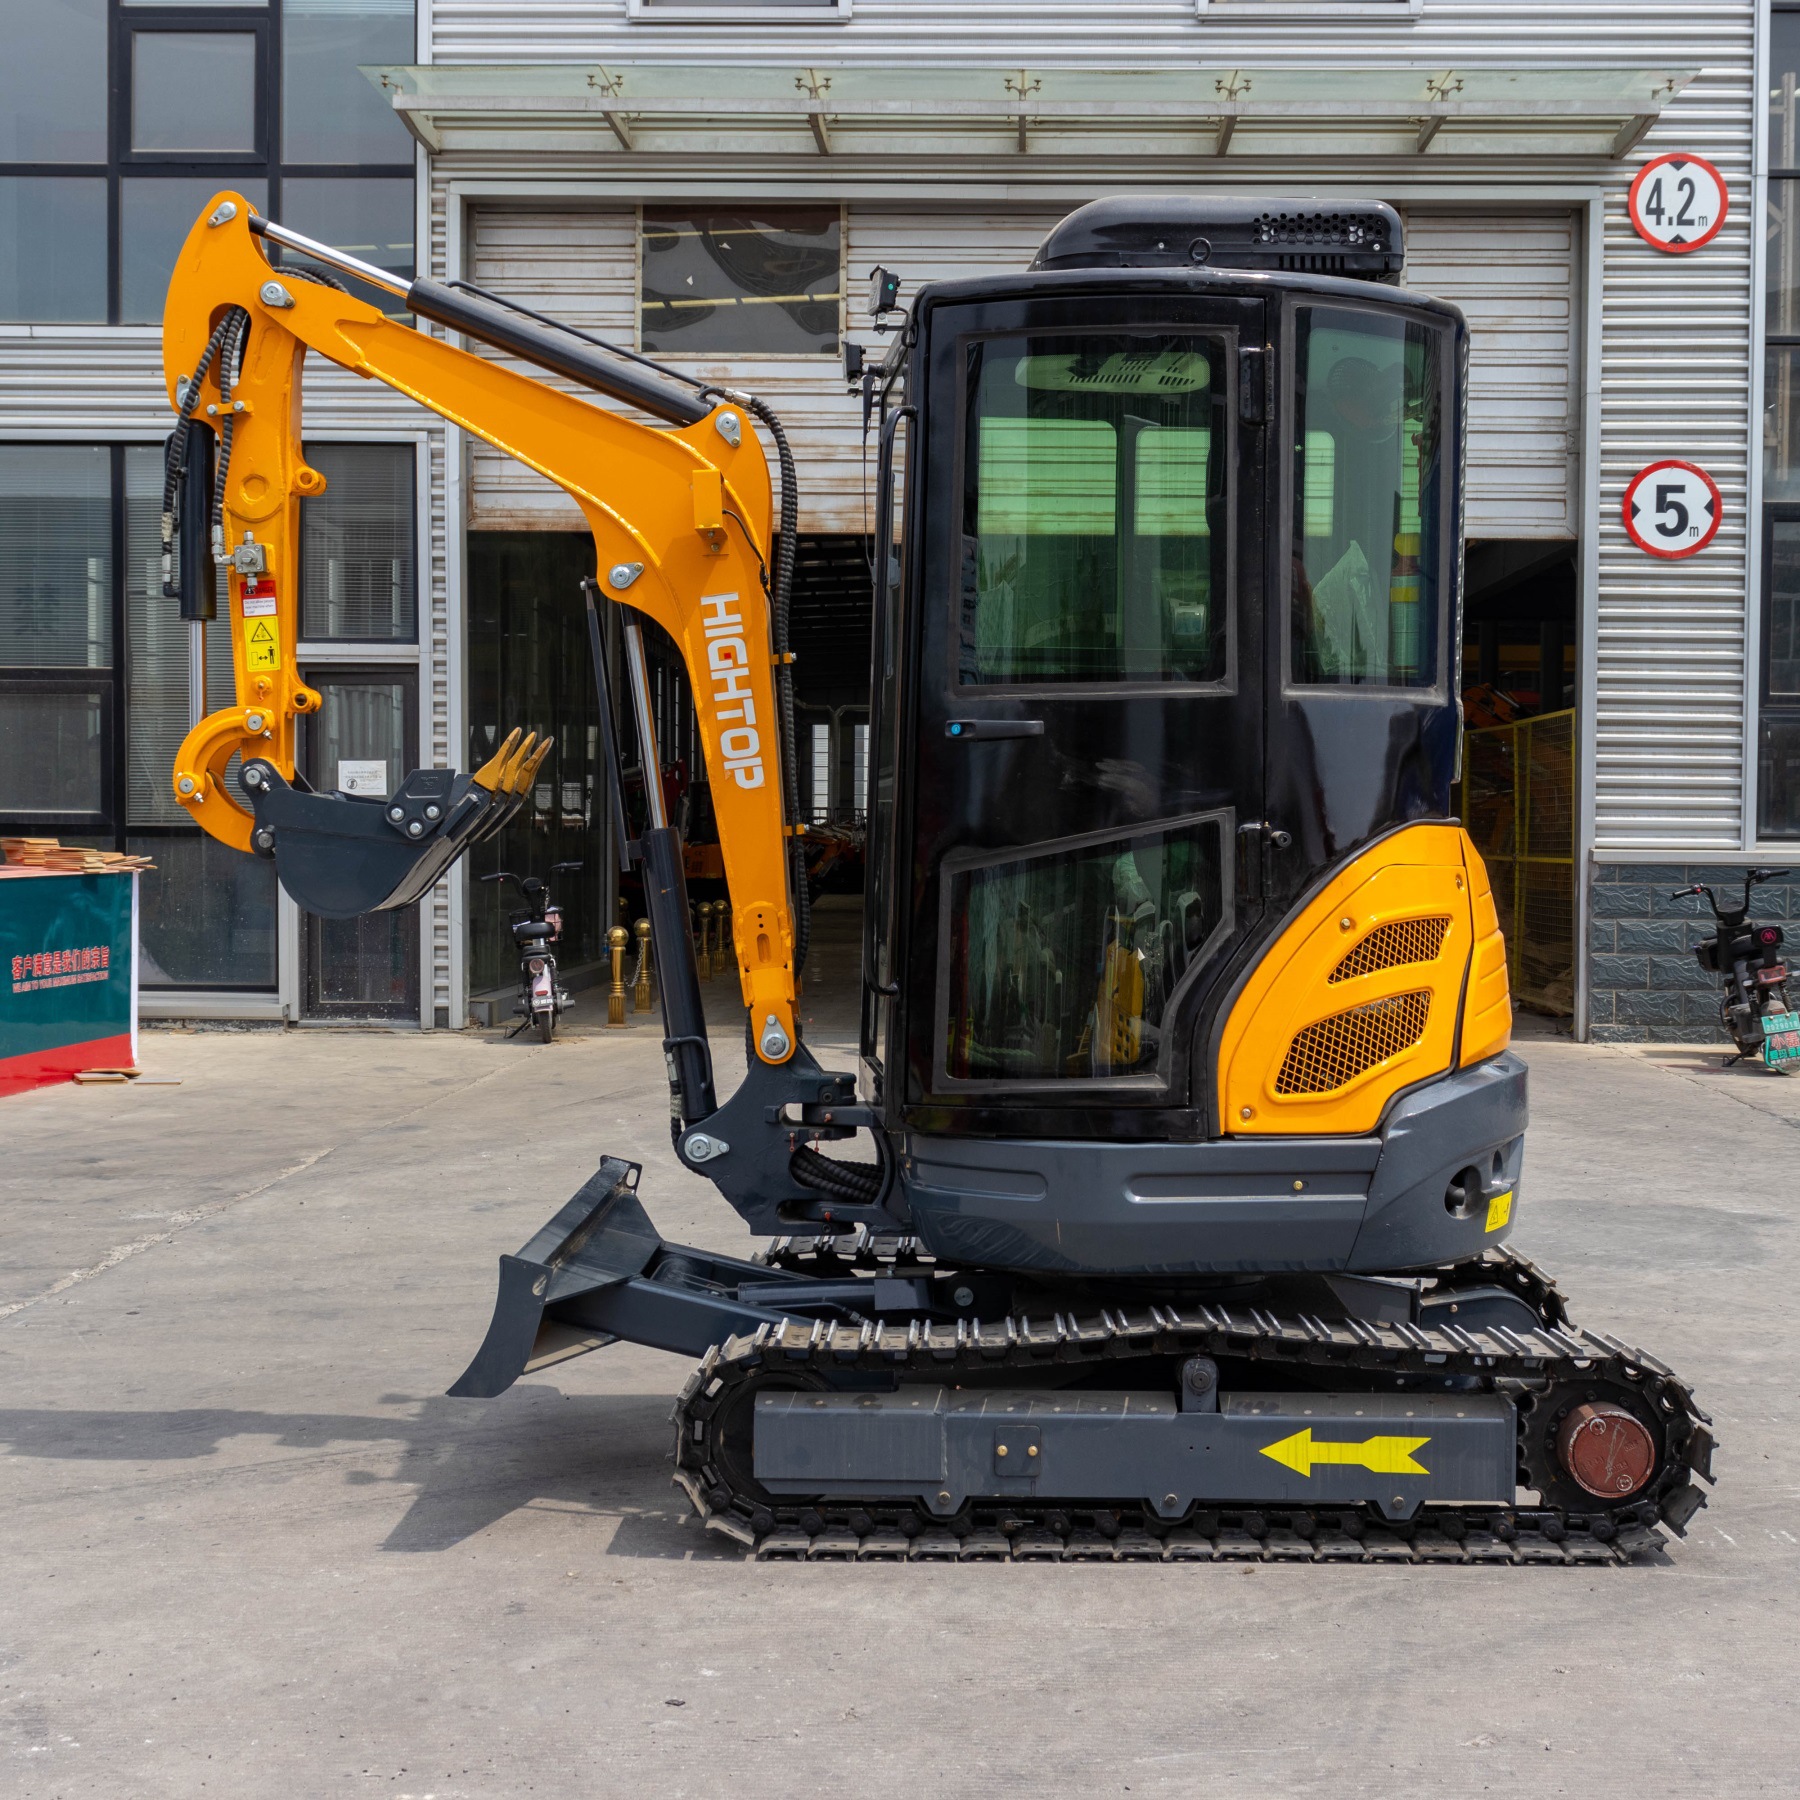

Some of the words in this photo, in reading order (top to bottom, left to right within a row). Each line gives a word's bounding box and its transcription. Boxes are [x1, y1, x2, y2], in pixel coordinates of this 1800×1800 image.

[700, 592, 766, 790] HIGHTOP
[12, 945, 109, 980] 客户满意是我们的宗旨
